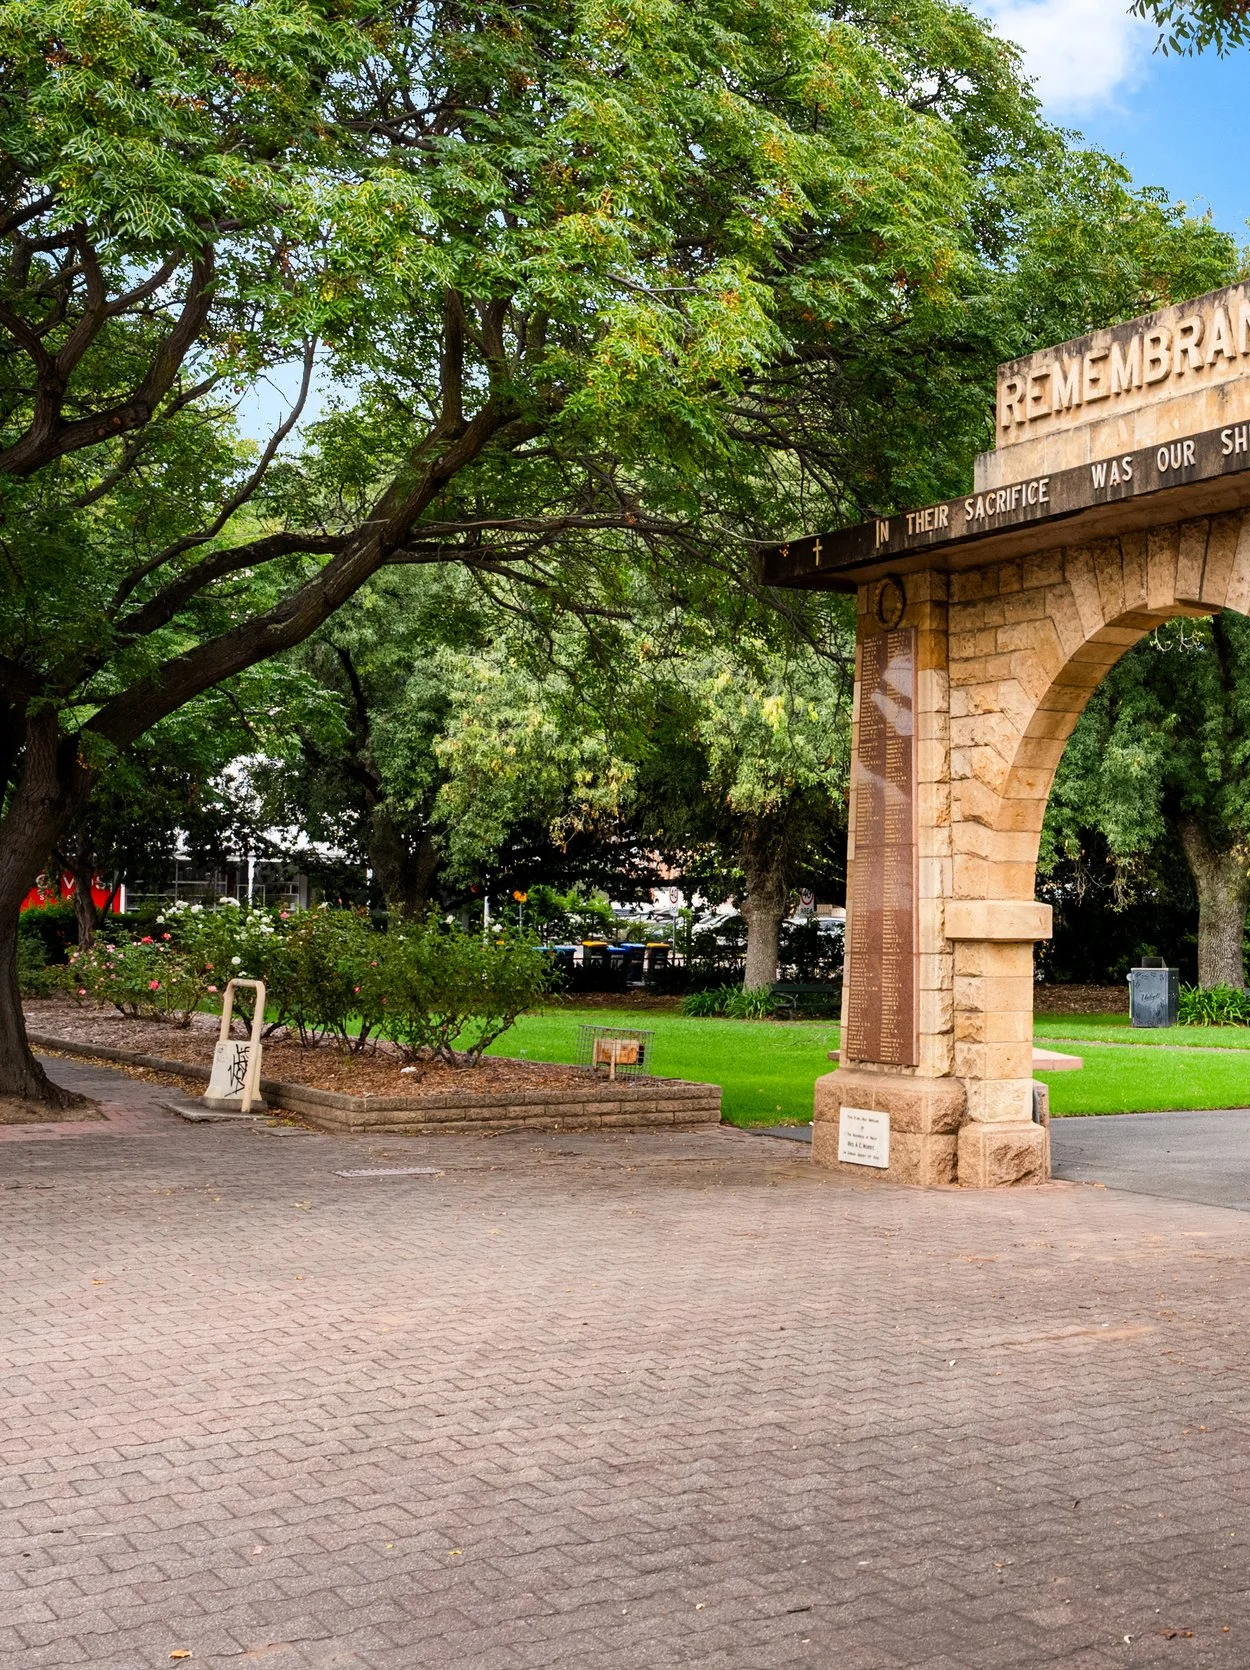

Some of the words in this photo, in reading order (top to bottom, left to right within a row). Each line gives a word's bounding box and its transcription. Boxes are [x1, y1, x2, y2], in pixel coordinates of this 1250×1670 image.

[875, 518, 890, 549] IN
[905, 504, 949, 537] THEIR
[964, 477, 1050, 522] SACRIFICE
[1091, 456, 1133, 490] WAS
[1156, 440, 1196, 474] OUR
